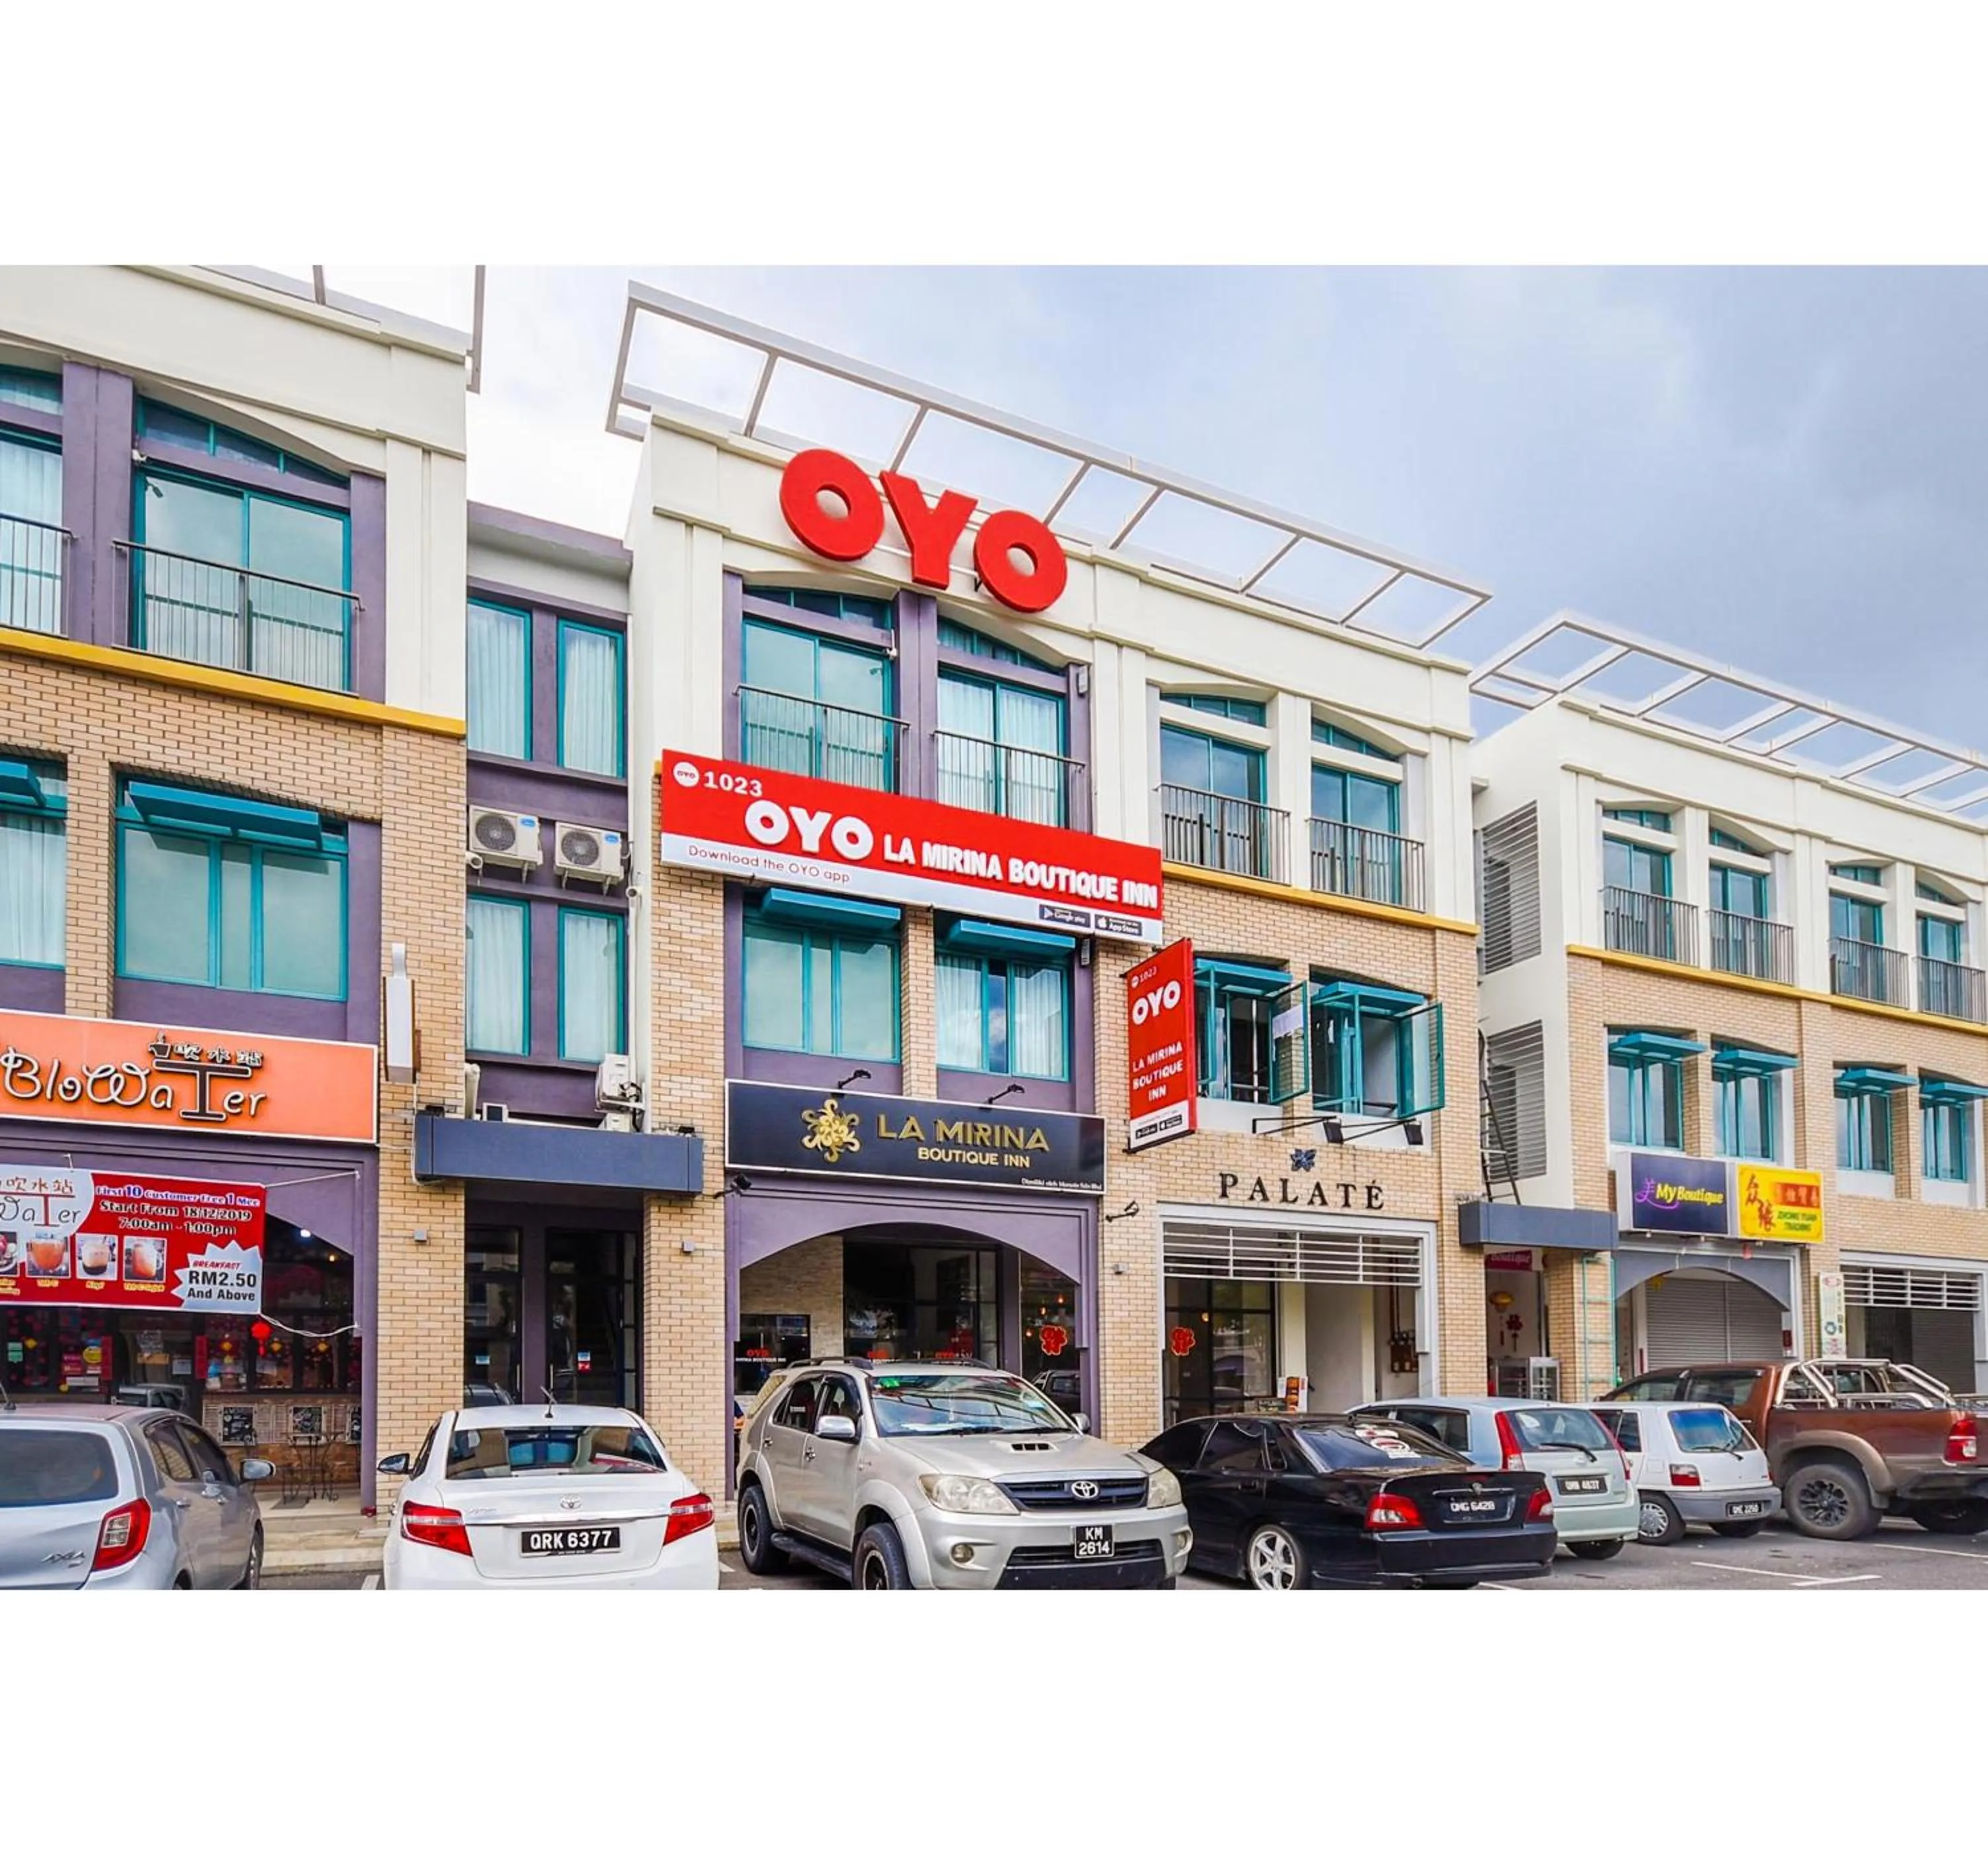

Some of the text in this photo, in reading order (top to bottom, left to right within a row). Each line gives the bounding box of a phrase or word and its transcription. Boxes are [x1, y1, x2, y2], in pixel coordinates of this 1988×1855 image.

[779, 449, 1067, 613] OYO
[703, 771, 763, 797] 1023
[689, 845, 850, 884] Download the OYO app
[745, 800, 1158, 908] OYO LA MIRINA BOUTIQUE INN
[1132, 980, 1182, 1026] OYO
[1132, 1041, 1183, 1073] LA MIRINA
[1132, 1060, 1184, 1090] BOUTIQUE
[1148, 1085, 1167, 1102] INN
[877, 1113, 1050, 1152] LA MIRINA
[917, 1147, 1030, 1169] BOUTIQUE INN
[124, 1185, 144, 1198] 10
[1219, 1171, 1384, 1210] PALATÉ
[100, 1200, 138, 1214] Start
[140, 1203, 179, 1217] From
[188, 1270, 256, 1288] RM2.50
[188, 1288, 256, 1302] And Above
[531, 1530, 612, 1550] QRK 6377
[1078, 1526, 1110, 1555] KM 2614
